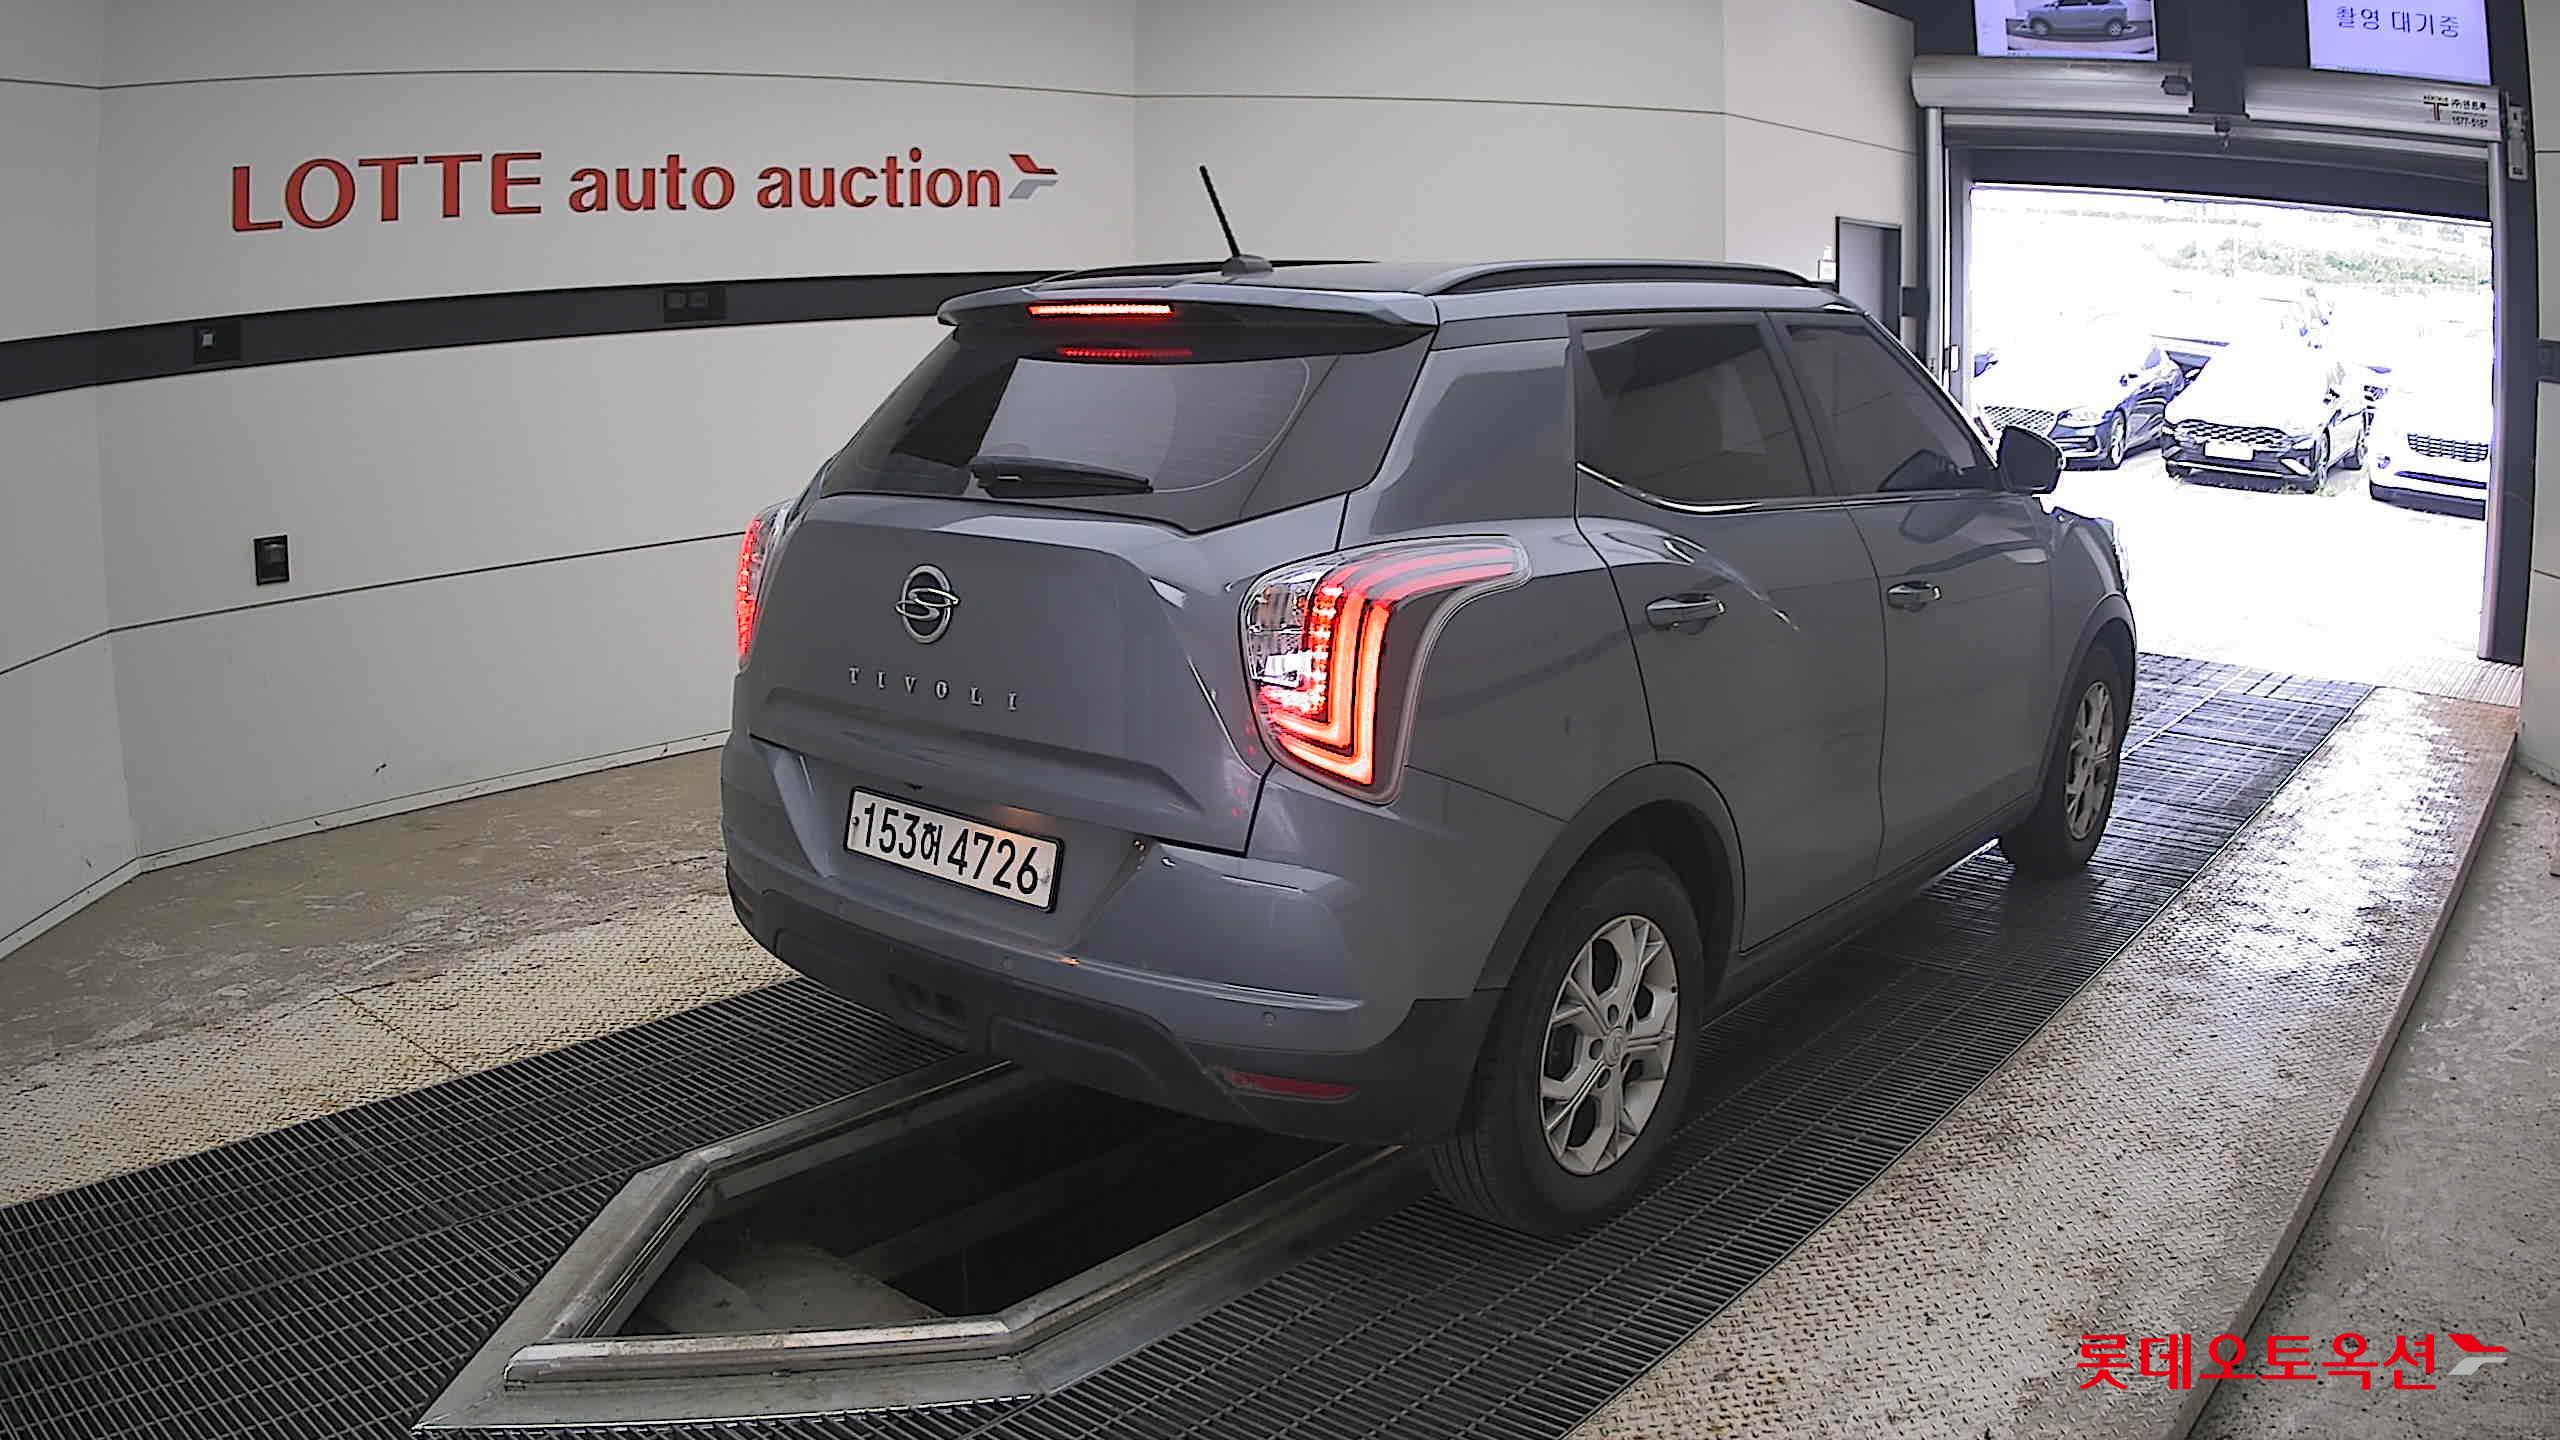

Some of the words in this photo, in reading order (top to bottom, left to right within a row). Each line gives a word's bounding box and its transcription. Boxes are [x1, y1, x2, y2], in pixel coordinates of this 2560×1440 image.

[2336, 6, 2380, 31] 촬영
[2391, 10, 2460, 39] 대기중
[231, 151, 543, 233] LOTTE
[567, 153, 736, 212] auto
[756, 147, 1002, 208] auction
[848, 666, 1018, 711] TIVOLI
[947, 828, 1040, 895] 4726
